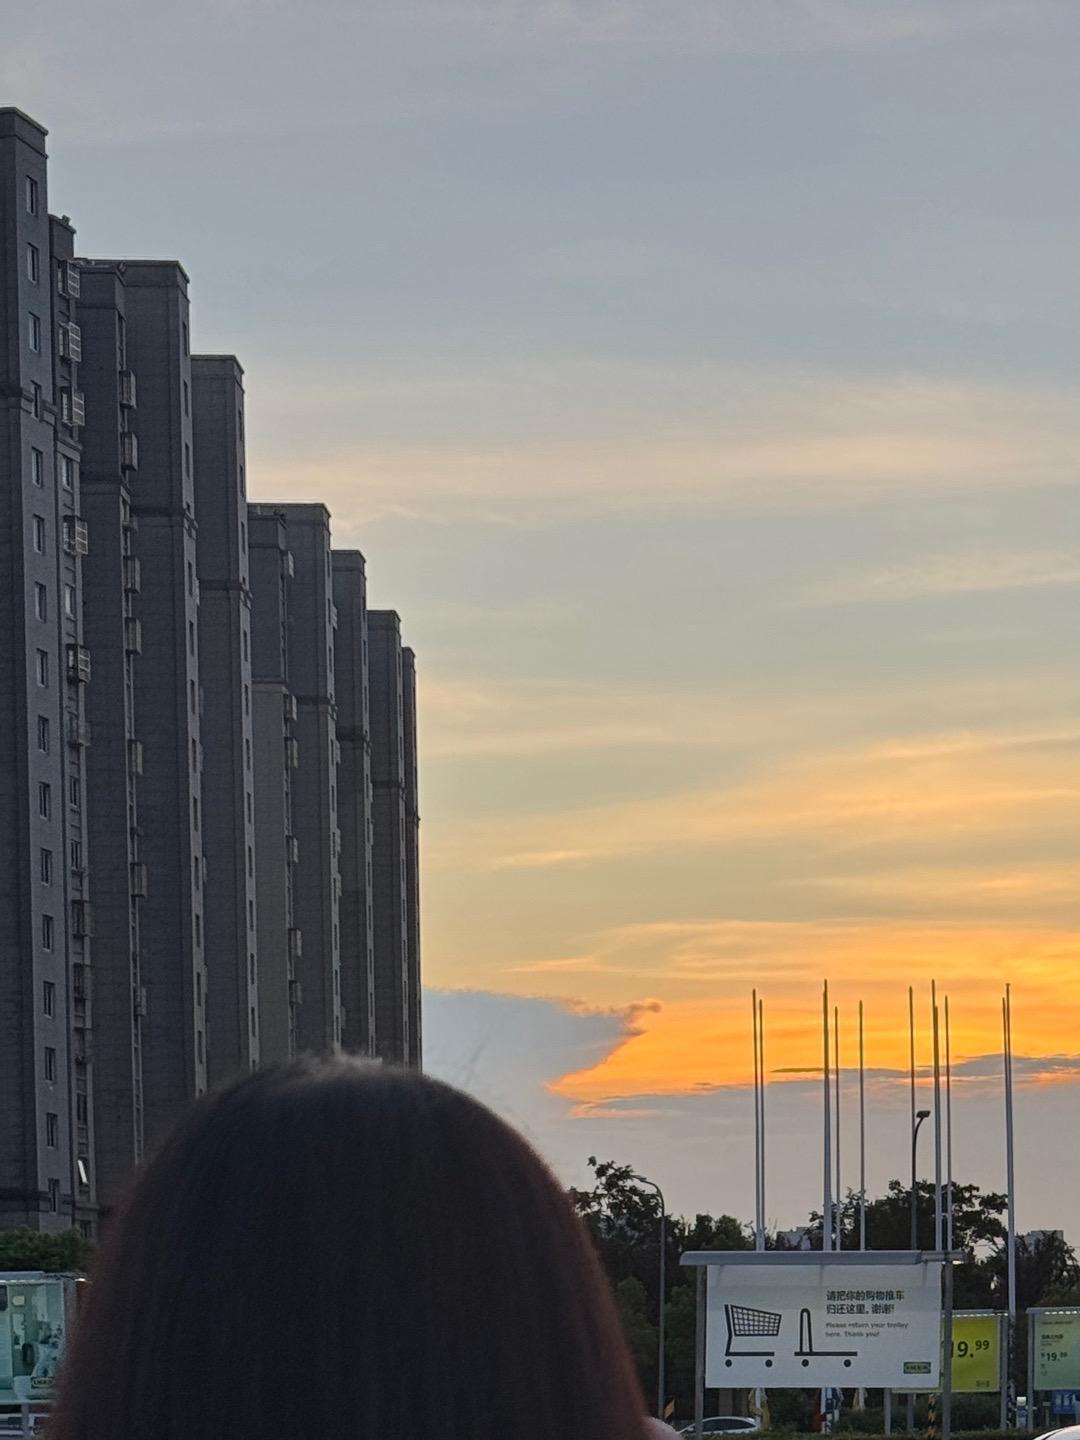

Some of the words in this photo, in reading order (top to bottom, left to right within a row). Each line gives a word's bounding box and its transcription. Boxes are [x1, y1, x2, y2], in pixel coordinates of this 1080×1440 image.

[826, 1290, 905, 1301] 请把你的购物推车
